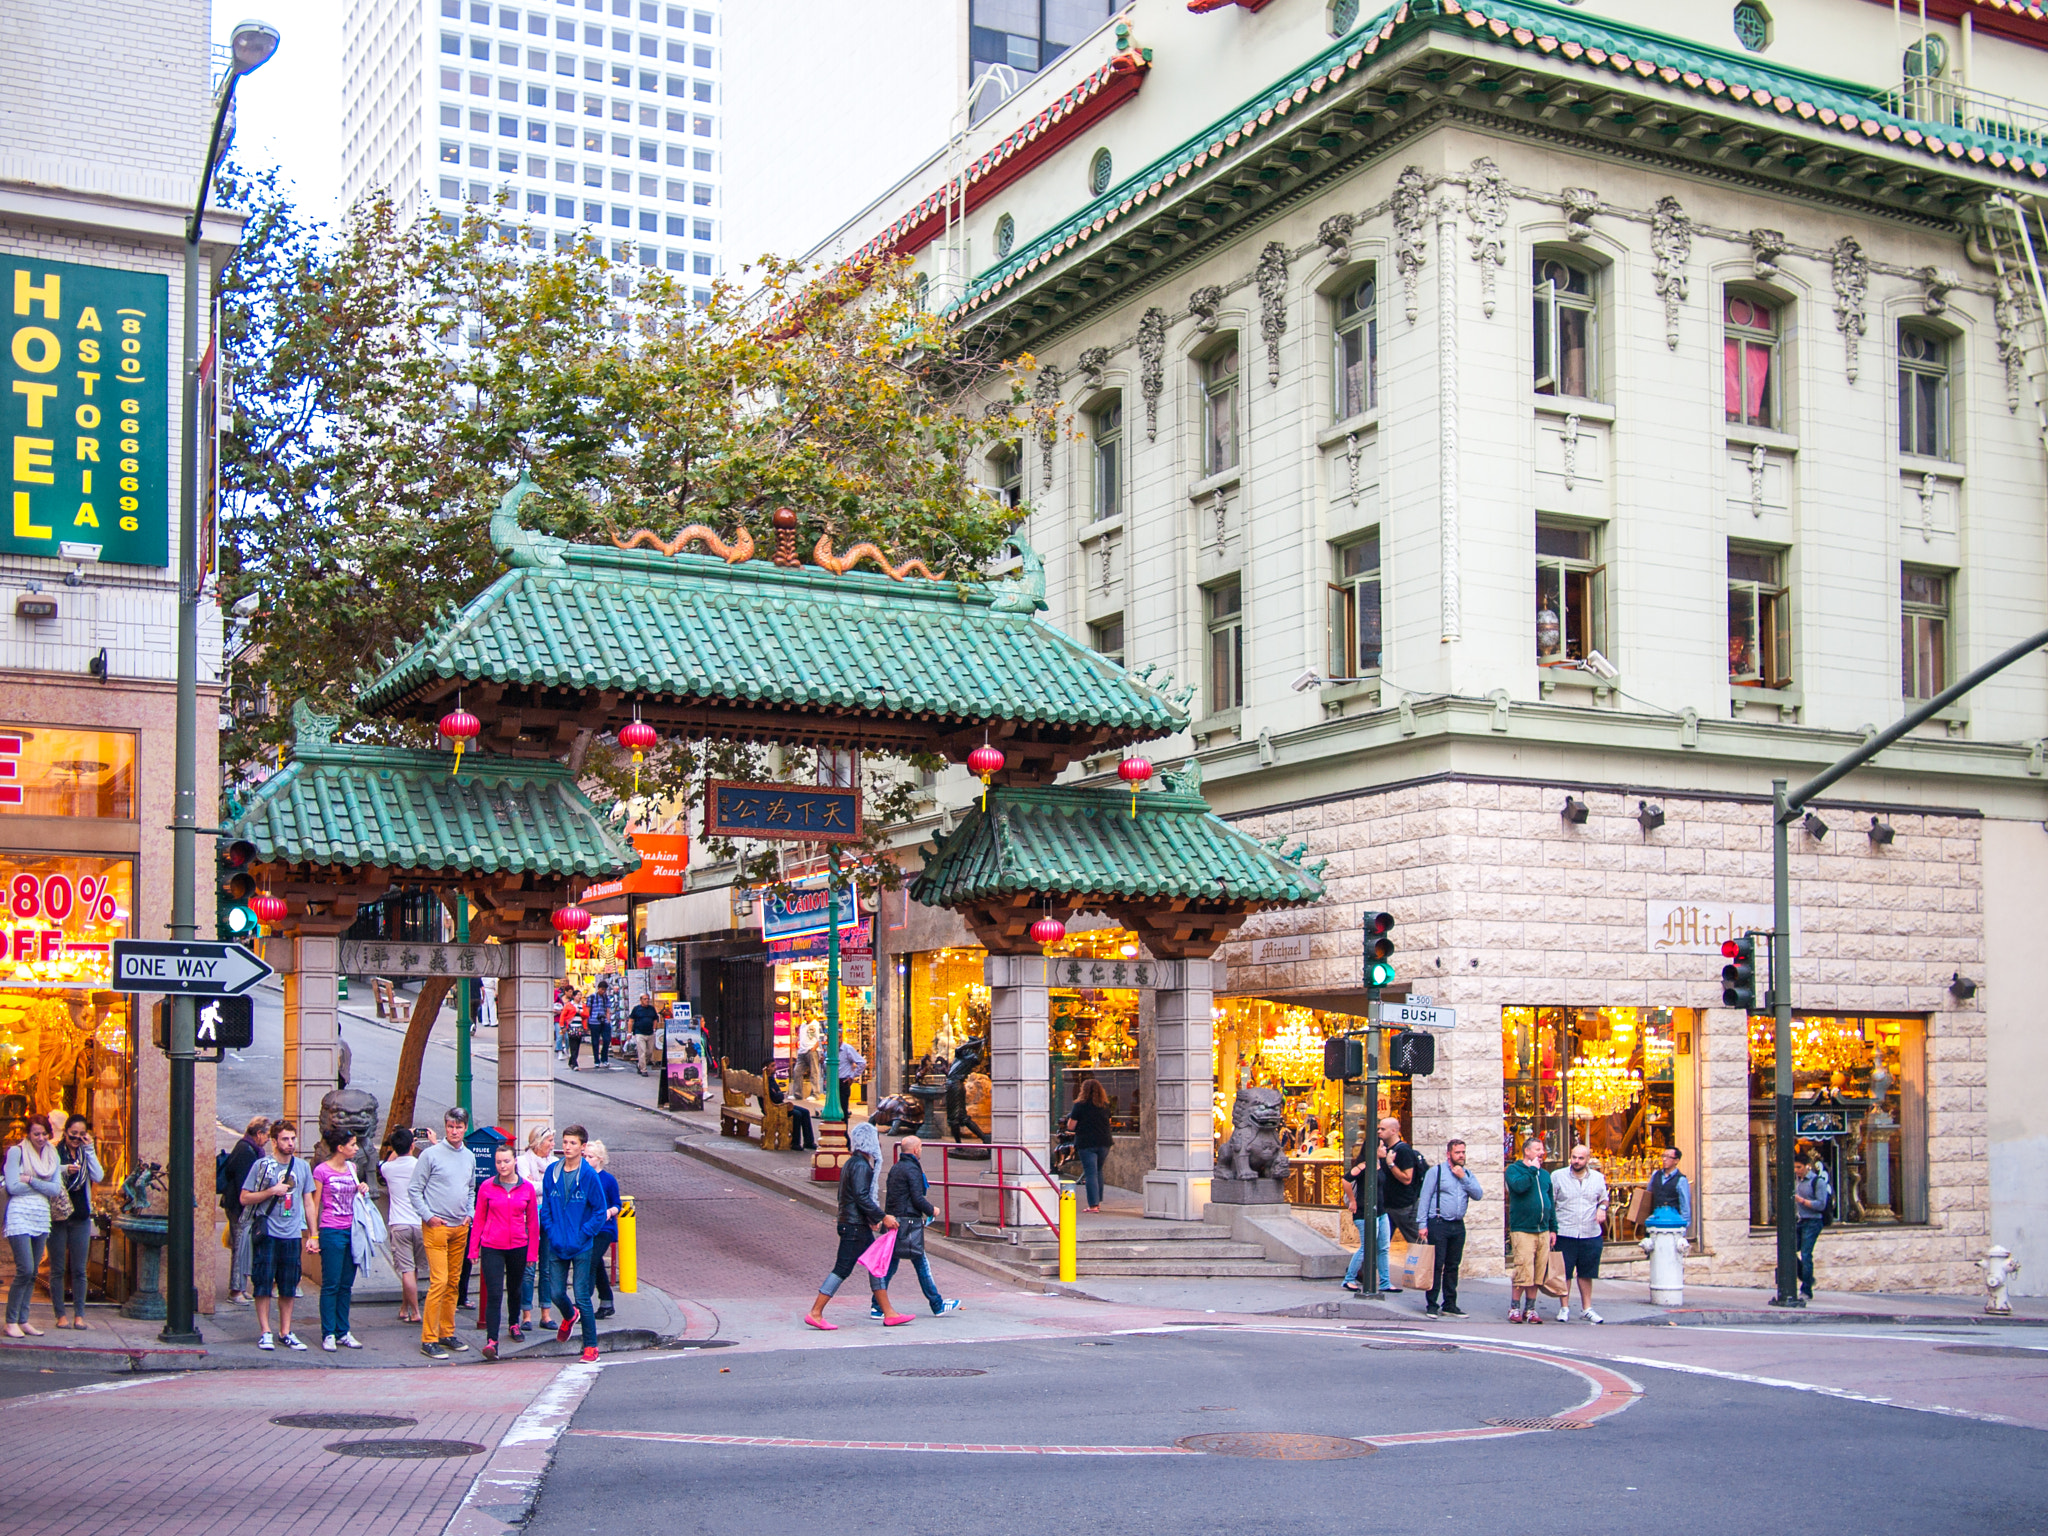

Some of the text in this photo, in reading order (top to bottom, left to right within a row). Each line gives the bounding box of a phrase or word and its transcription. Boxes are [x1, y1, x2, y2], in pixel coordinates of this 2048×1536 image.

[11, 269, 61, 539] HOTEL
[73, 306, 102, 528] ASTORIA
[115, 308, 146, 531] (800) 6666696
[597, 880, 623, 896] Souvenirs
[785, 889, 829, 915] Canon
[842, 953, 851, 961] NO
[1259, 939, 1302, 961] Michael
[126, 957, 218, 978] ONE WAY
[849, 971, 865, 979] TIME
[1416, 996, 1430, 1005] 500
[1401, 1008, 1437, 1023] BUSH
